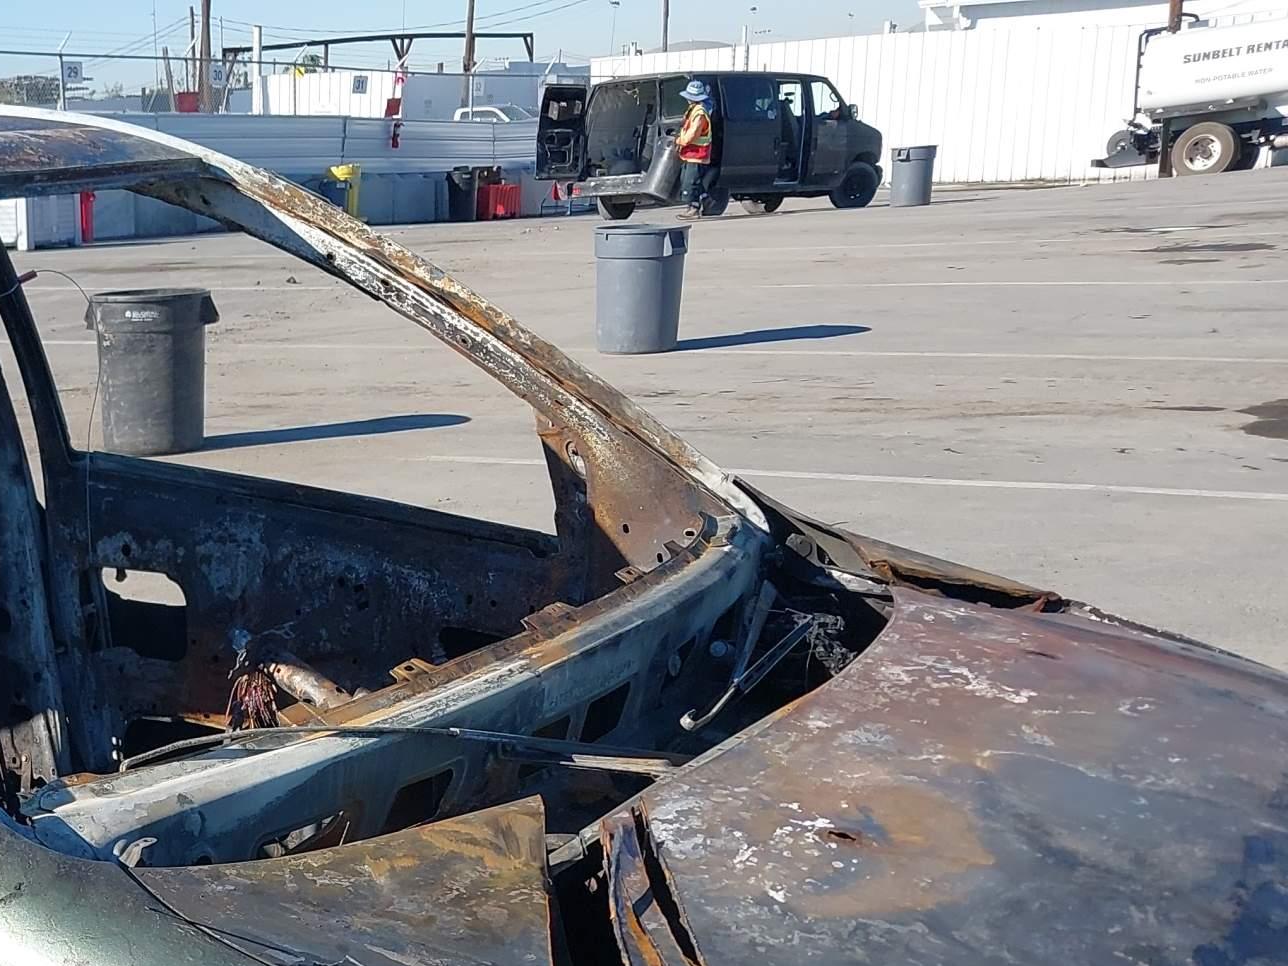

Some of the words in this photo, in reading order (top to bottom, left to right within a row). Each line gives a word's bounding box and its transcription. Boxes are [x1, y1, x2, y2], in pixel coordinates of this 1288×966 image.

[1183, 46, 1243, 64] SUNBELT
[67, 66, 79, 79] 29
[213, 70, 223, 81] 30
